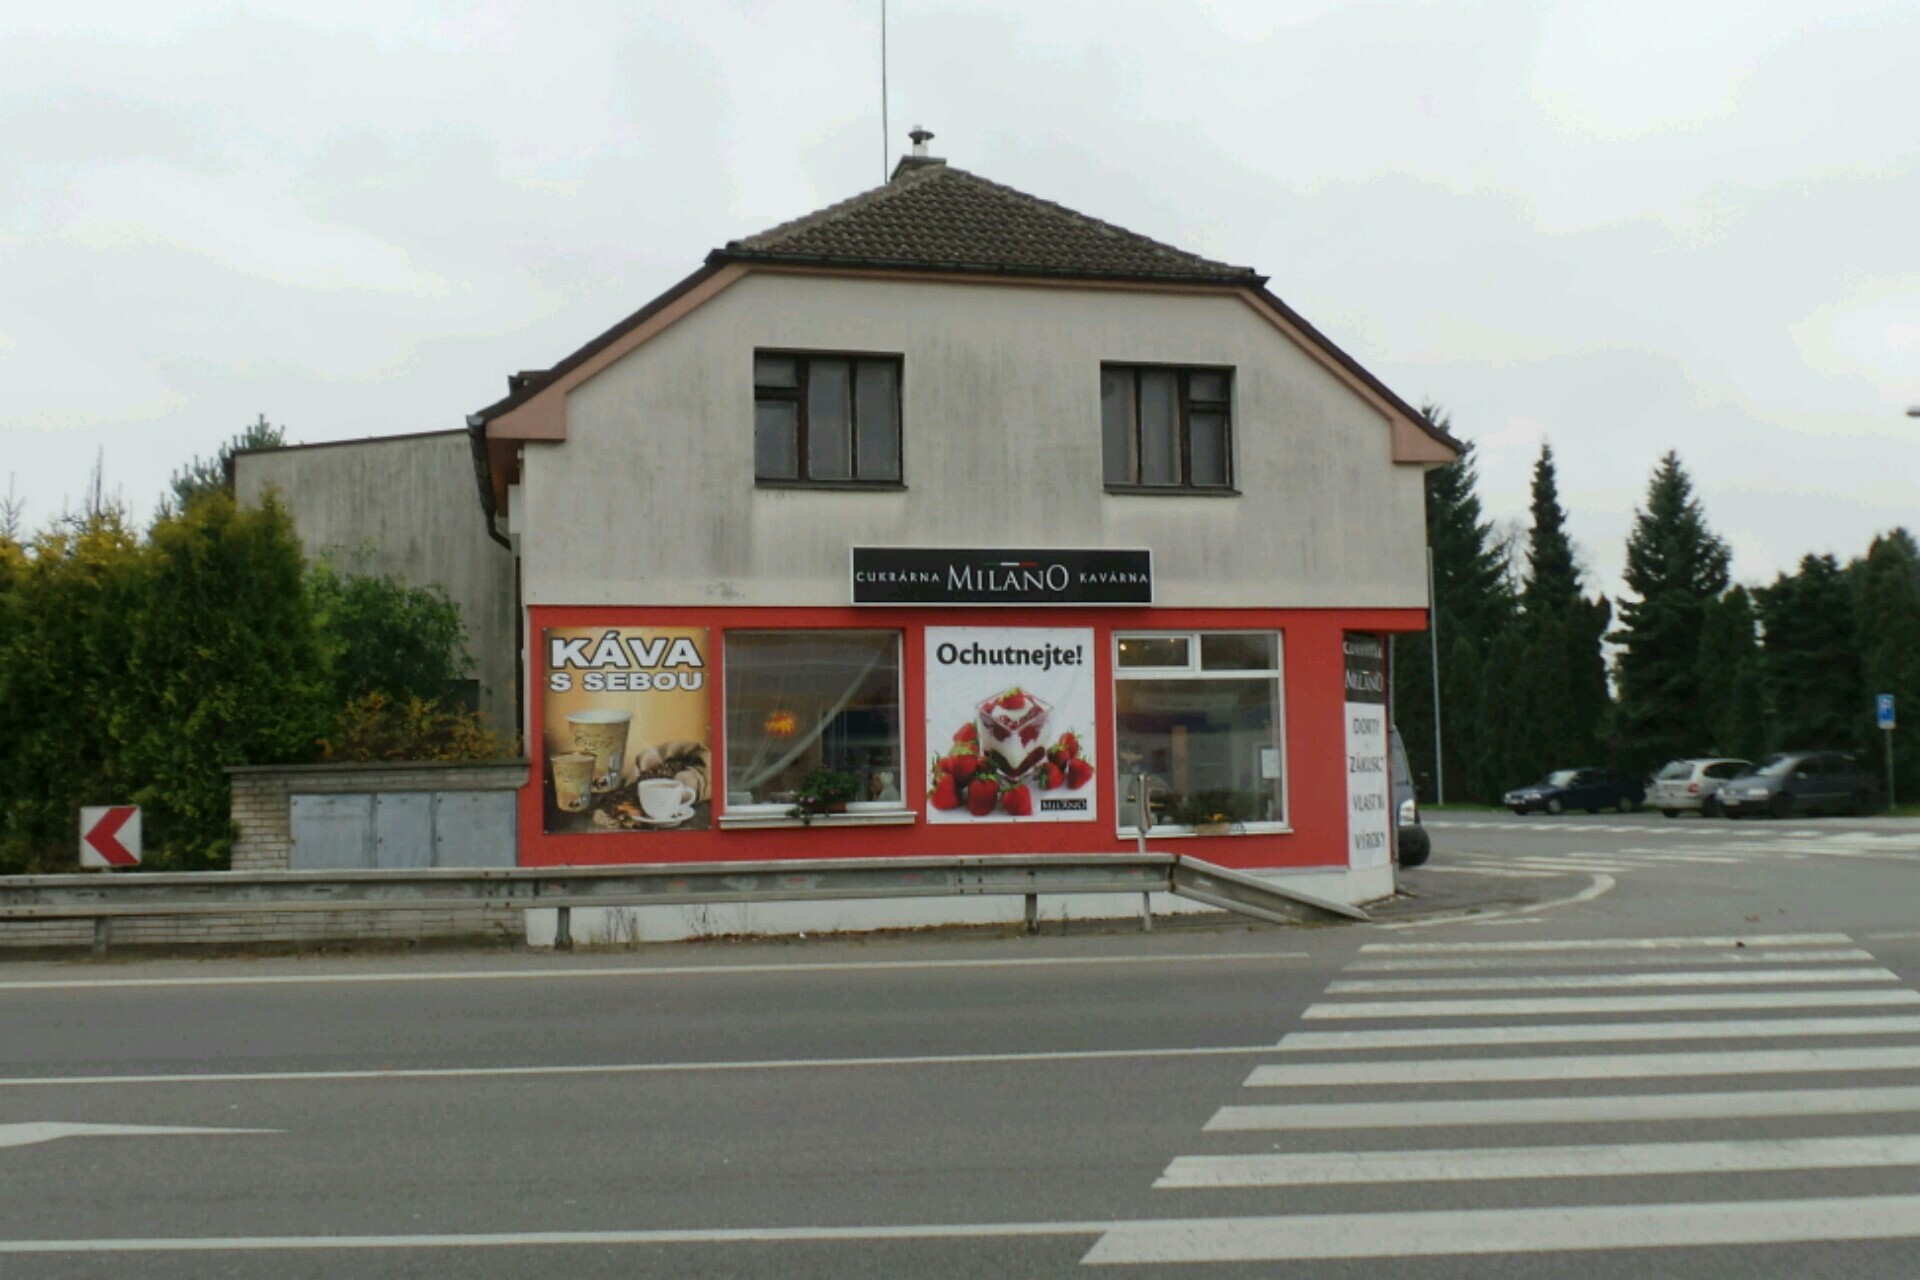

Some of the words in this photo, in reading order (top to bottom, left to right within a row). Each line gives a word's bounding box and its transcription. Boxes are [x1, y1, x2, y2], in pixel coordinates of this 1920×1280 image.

[856, 569, 941, 583] CUKRÁRNA
[947, 564, 1069, 591] MILANO
[1079, 570, 1149, 583] KAVÁRNA
[551, 630, 703, 668] KÁVA
[936, 641, 1083, 672] Ochutnejte!
[550, 672, 572, 692] S
[583, 671, 703, 692] SEBOU
